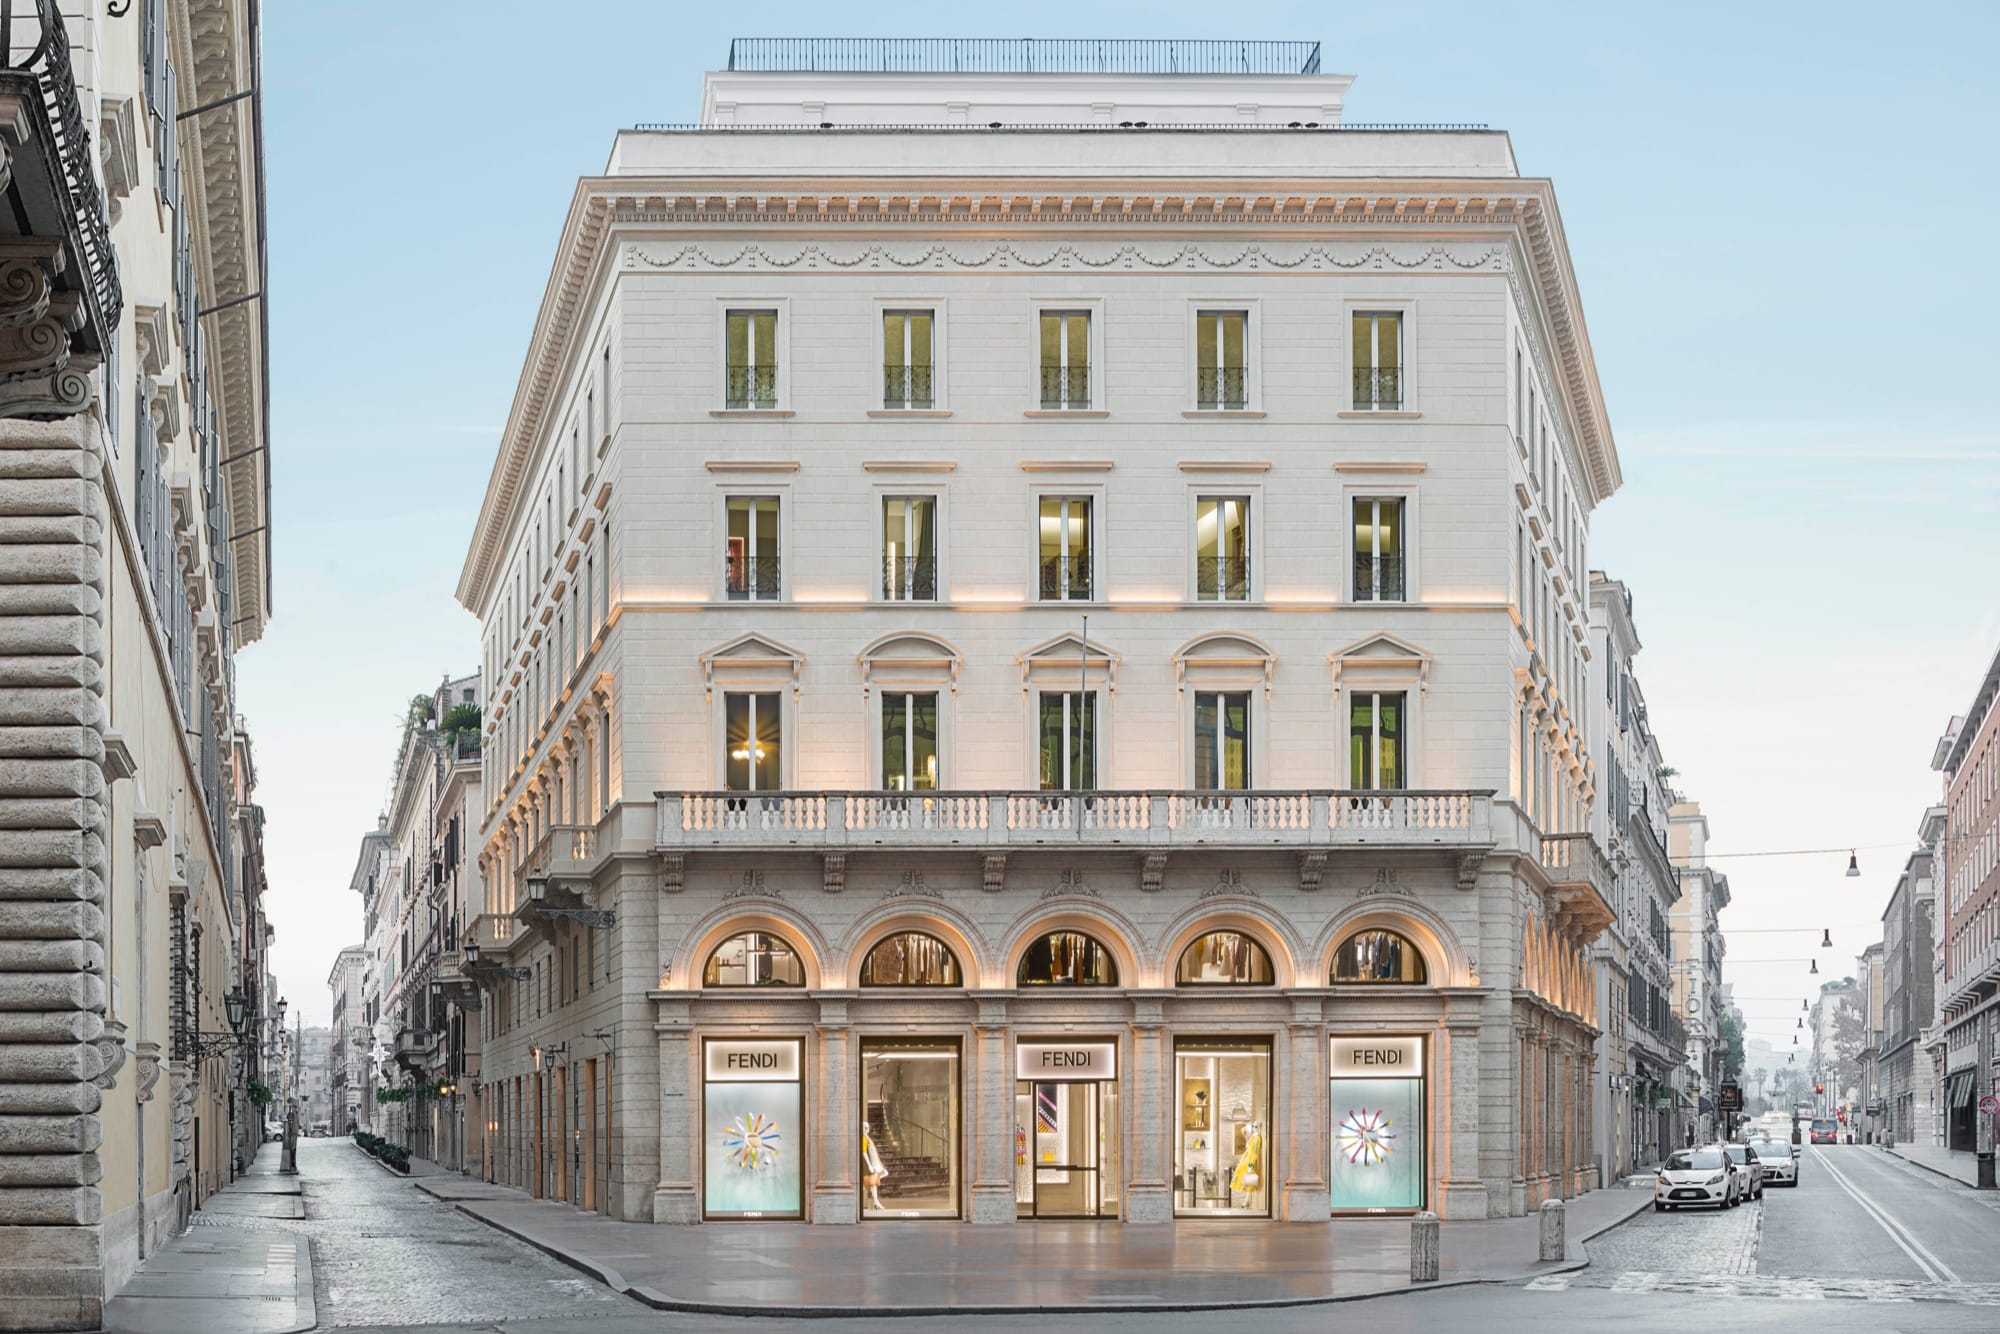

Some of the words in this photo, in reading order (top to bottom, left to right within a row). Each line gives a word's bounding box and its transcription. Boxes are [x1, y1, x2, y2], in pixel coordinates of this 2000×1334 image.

[728, 1053, 777, 1068] FENDI
[1042, 1051, 1091, 1067] FENDI
[1353, 1050, 1402, 1065] FENDI
